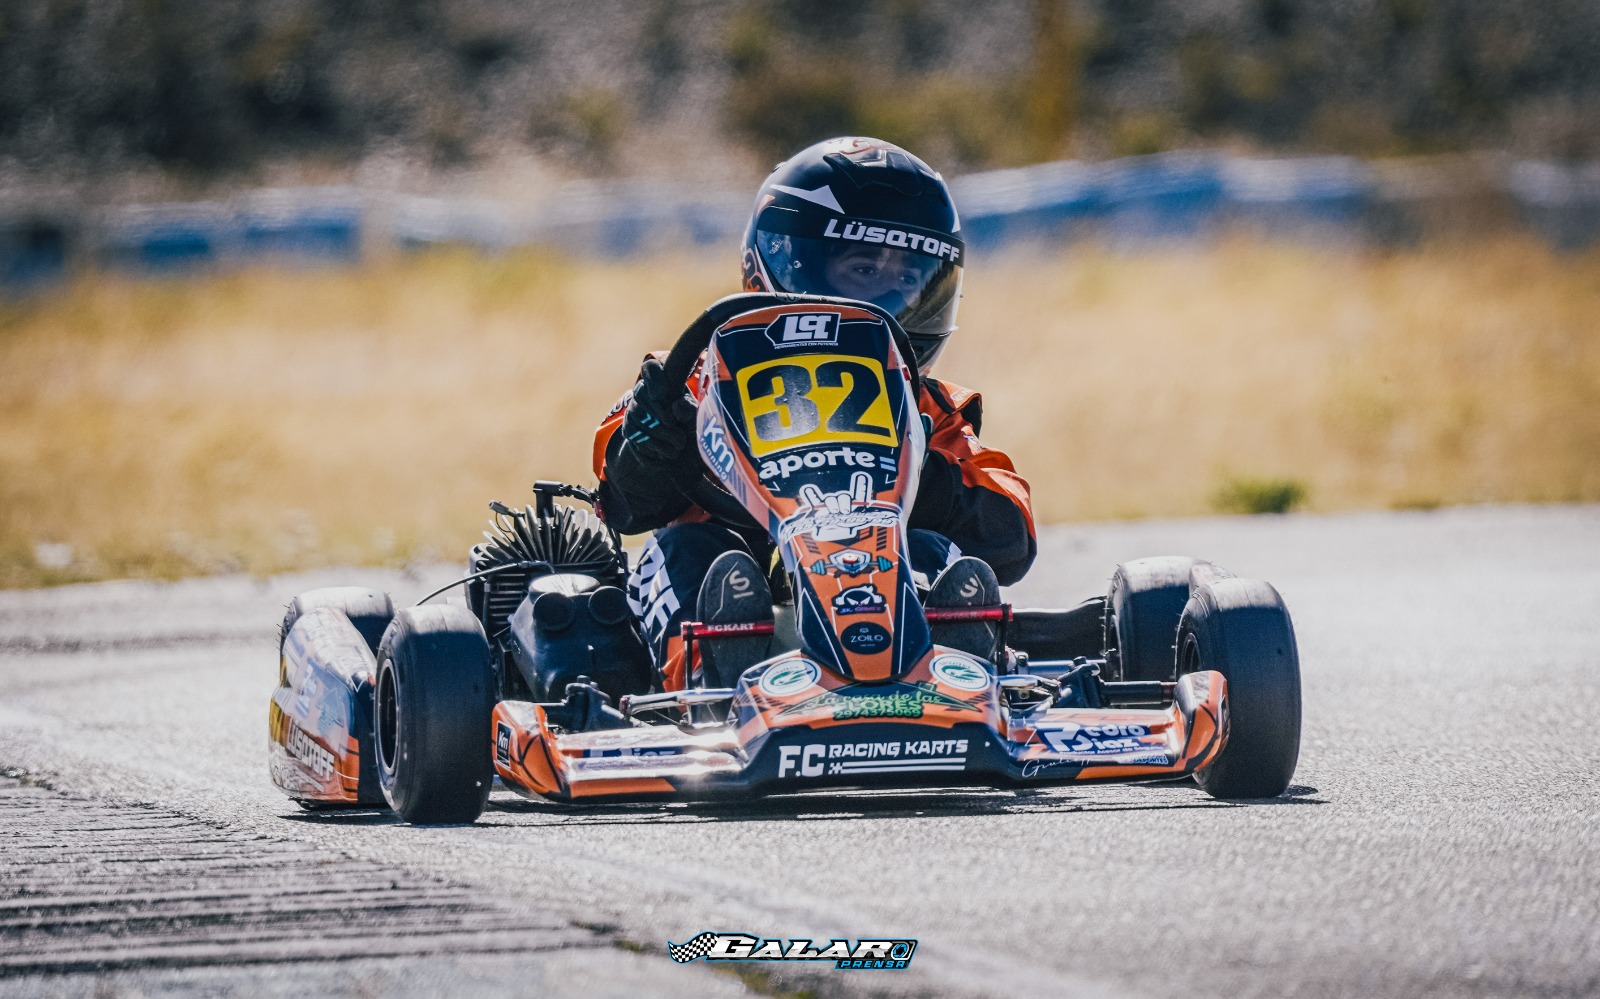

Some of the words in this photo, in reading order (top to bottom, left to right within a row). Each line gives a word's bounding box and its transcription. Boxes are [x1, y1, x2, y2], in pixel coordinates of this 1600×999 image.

[823, 218, 960, 262] LÜSQTOFF
[747, 361, 892, 442] 32
[700, 437, 728, 480] running
[703, 416, 735, 473] Km
[759, 447, 876, 479] aporte
[834, 699, 922, 711] FLORES
[888, 690, 912, 701] de
[915, 690, 942, 704] las
[829, 741, 901, 759] RACING
[905, 739, 969, 756] KARTS
